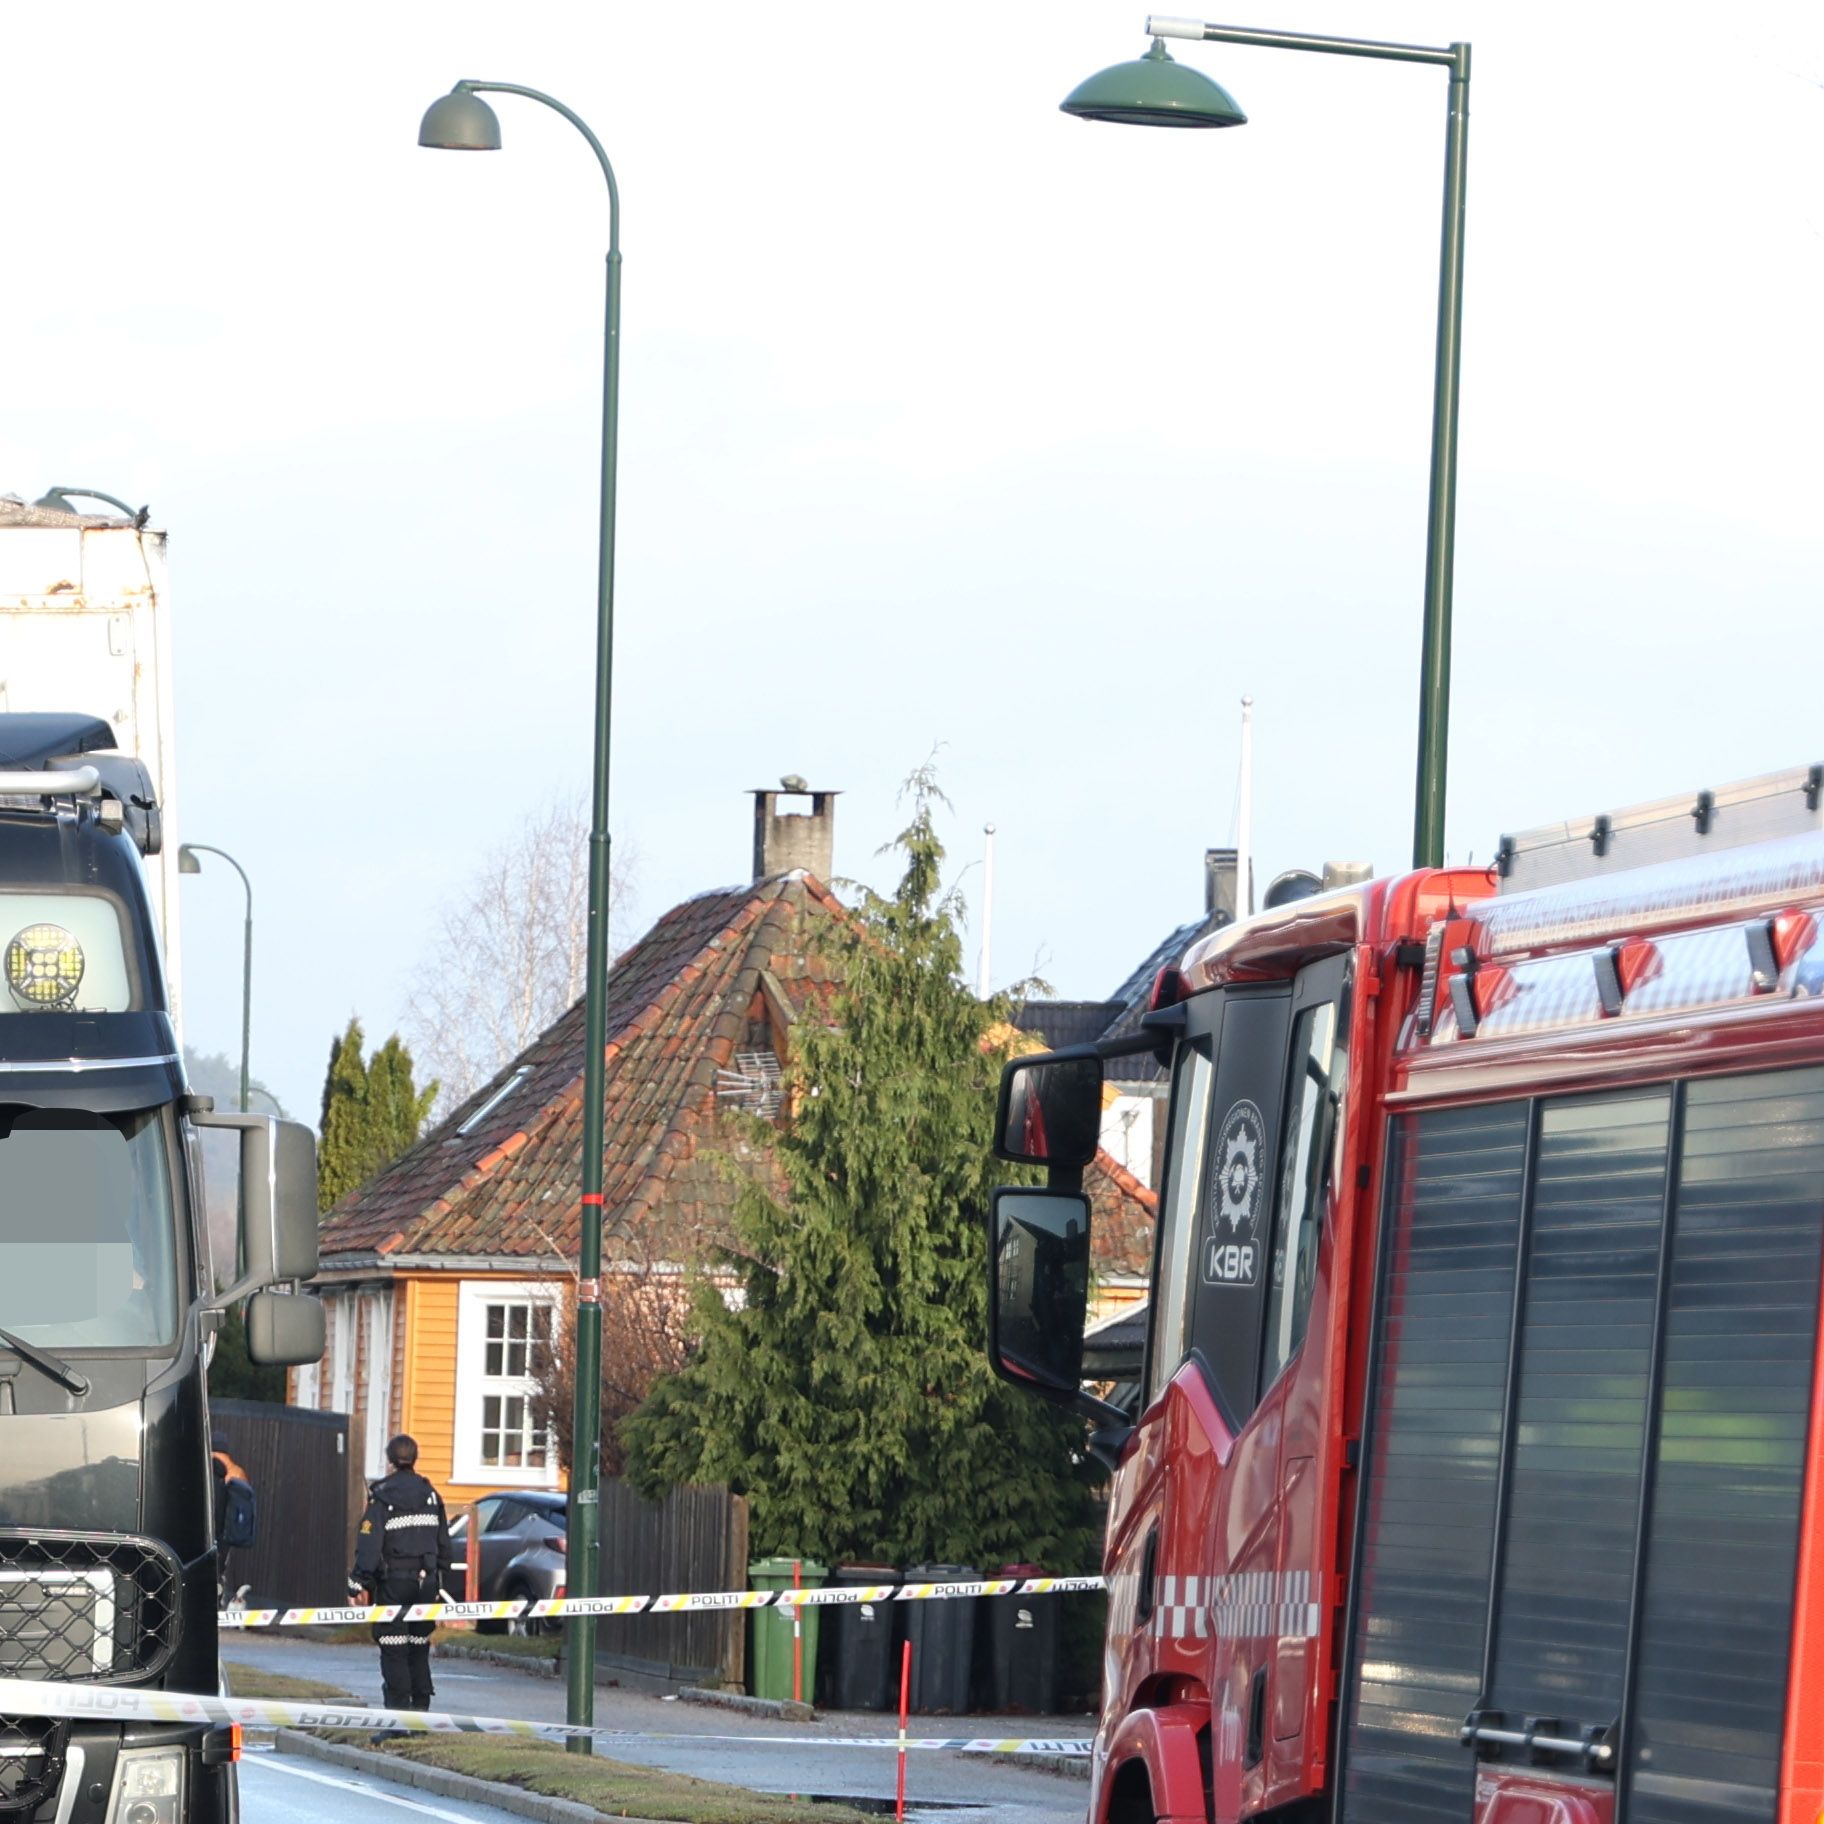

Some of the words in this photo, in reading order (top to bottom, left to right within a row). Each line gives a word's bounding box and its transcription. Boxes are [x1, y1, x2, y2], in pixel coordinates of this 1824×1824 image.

[1209, 1244, 1254, 1279] KBR
[934, 1585, 982, 1595] POLITI
[691, 1595, 739, 1605] POLITI
[444, 1604, 493, 1614] POLITI
[566, 1602, 614, 1612] POLITI
[317, 1611, 366, 1621] POLITI
